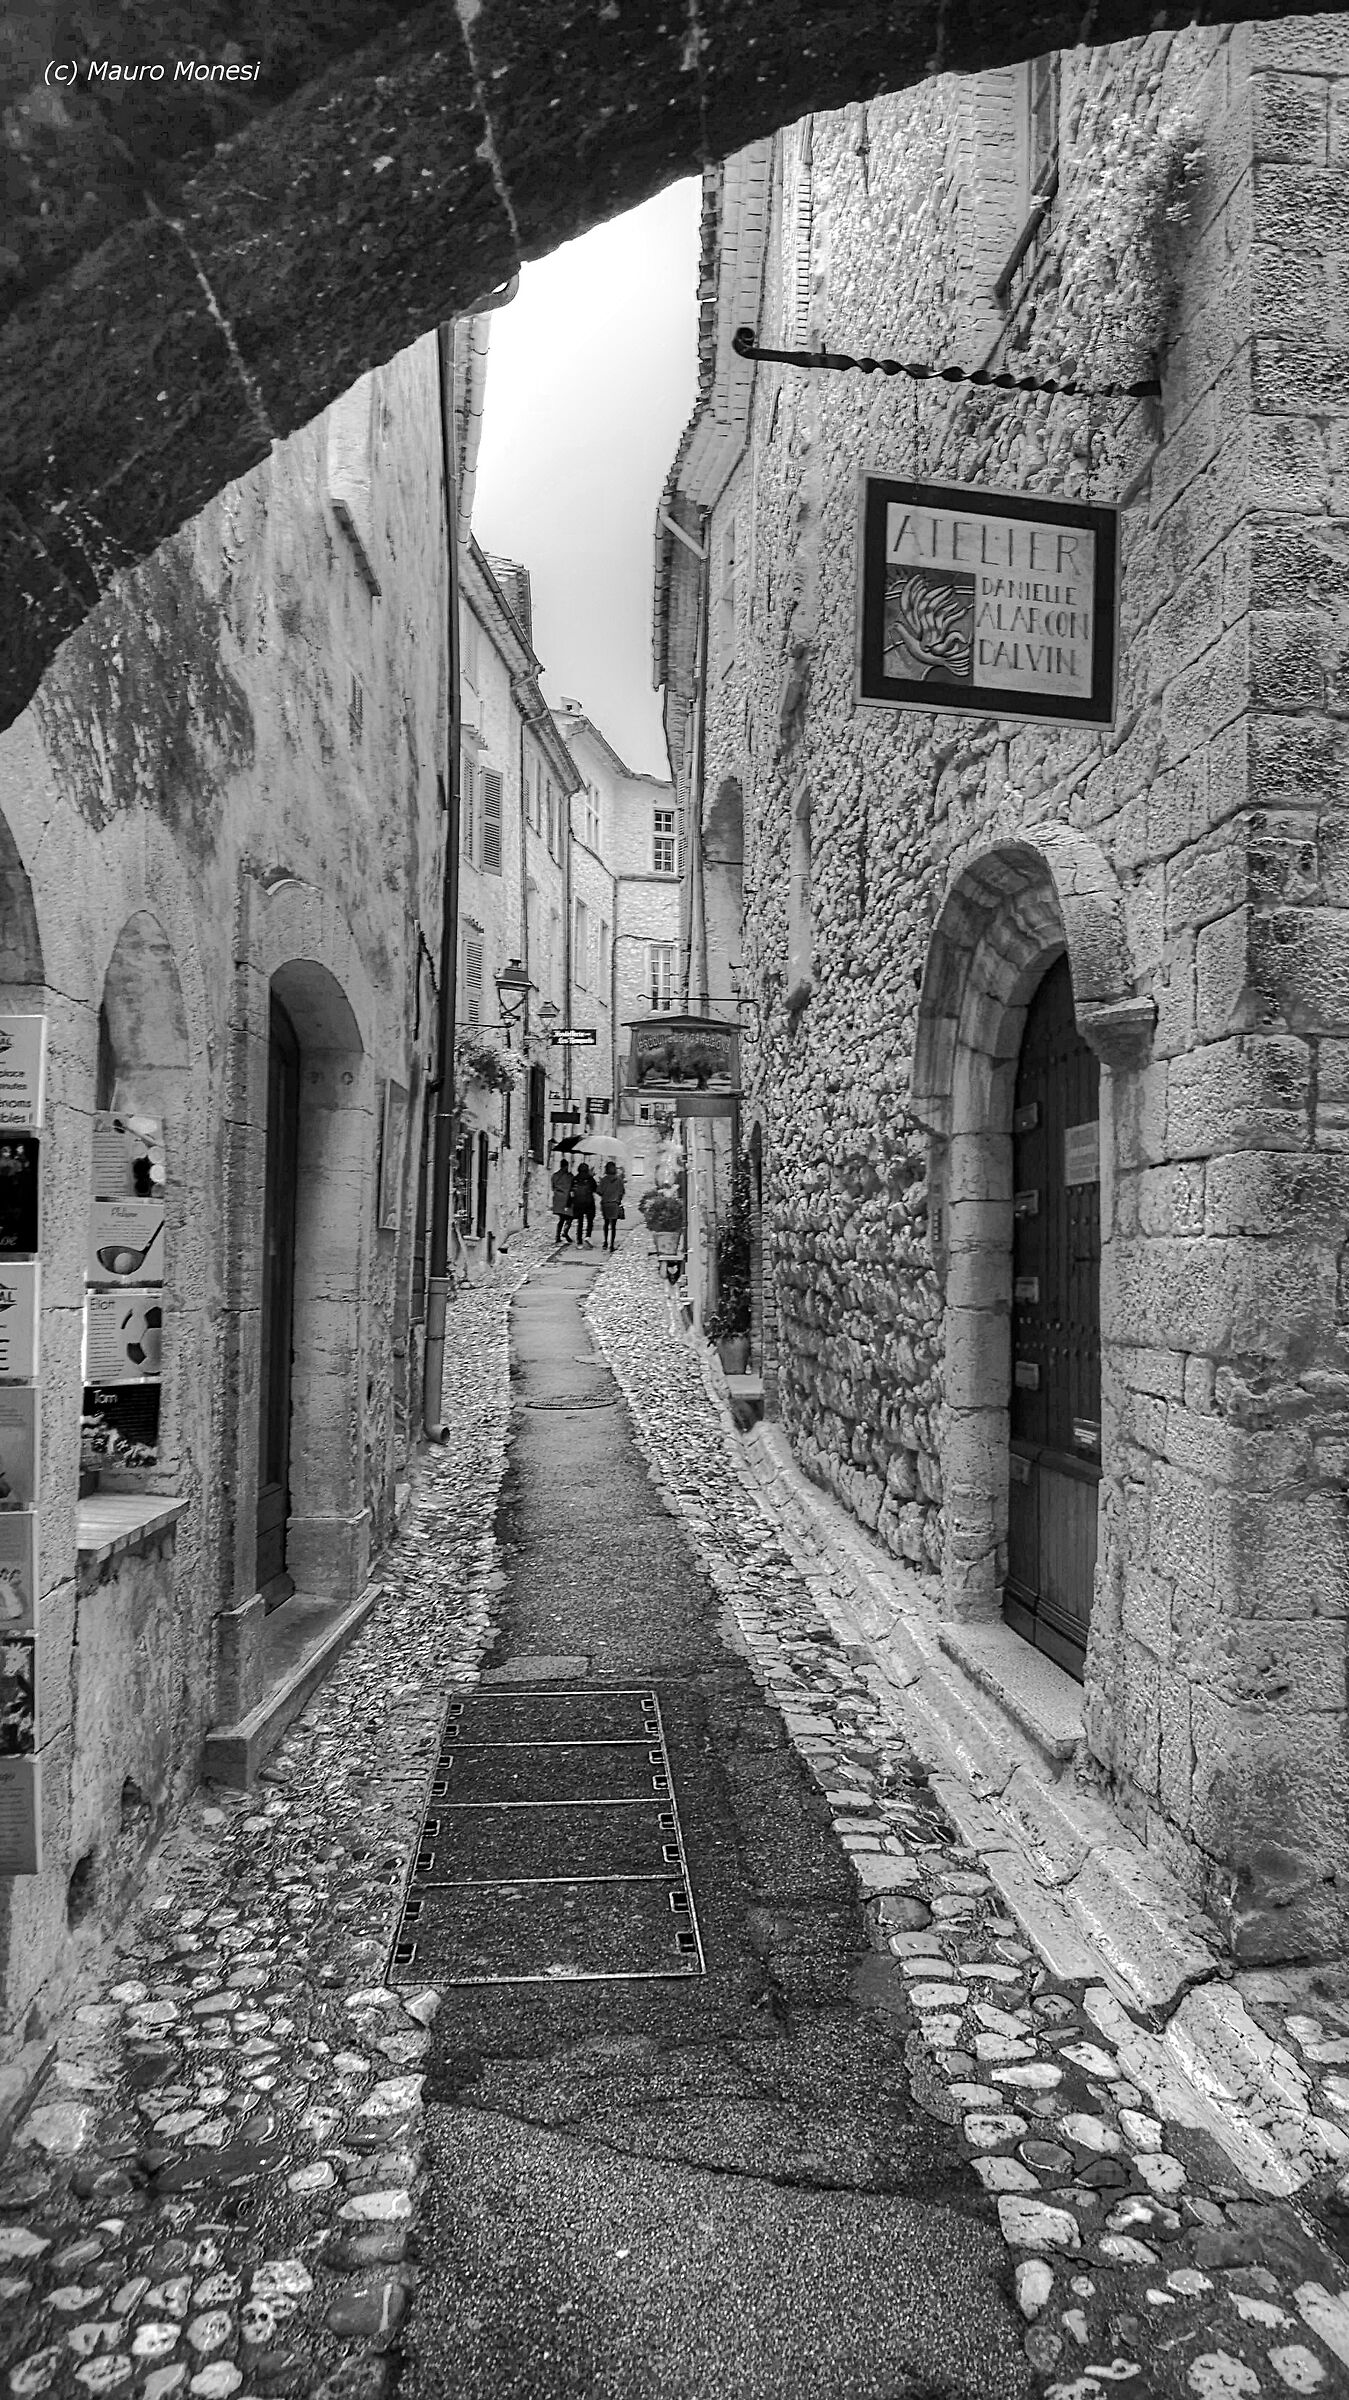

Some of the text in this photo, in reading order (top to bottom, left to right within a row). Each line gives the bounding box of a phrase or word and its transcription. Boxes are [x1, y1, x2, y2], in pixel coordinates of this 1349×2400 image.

[893, 515, 1081, 576] ATELIER
[981, 577, 1077, 606] DANIELLE
[976, 602, 1089, 640] ALARCON
[92, 1389, 118, 1404] Tom
